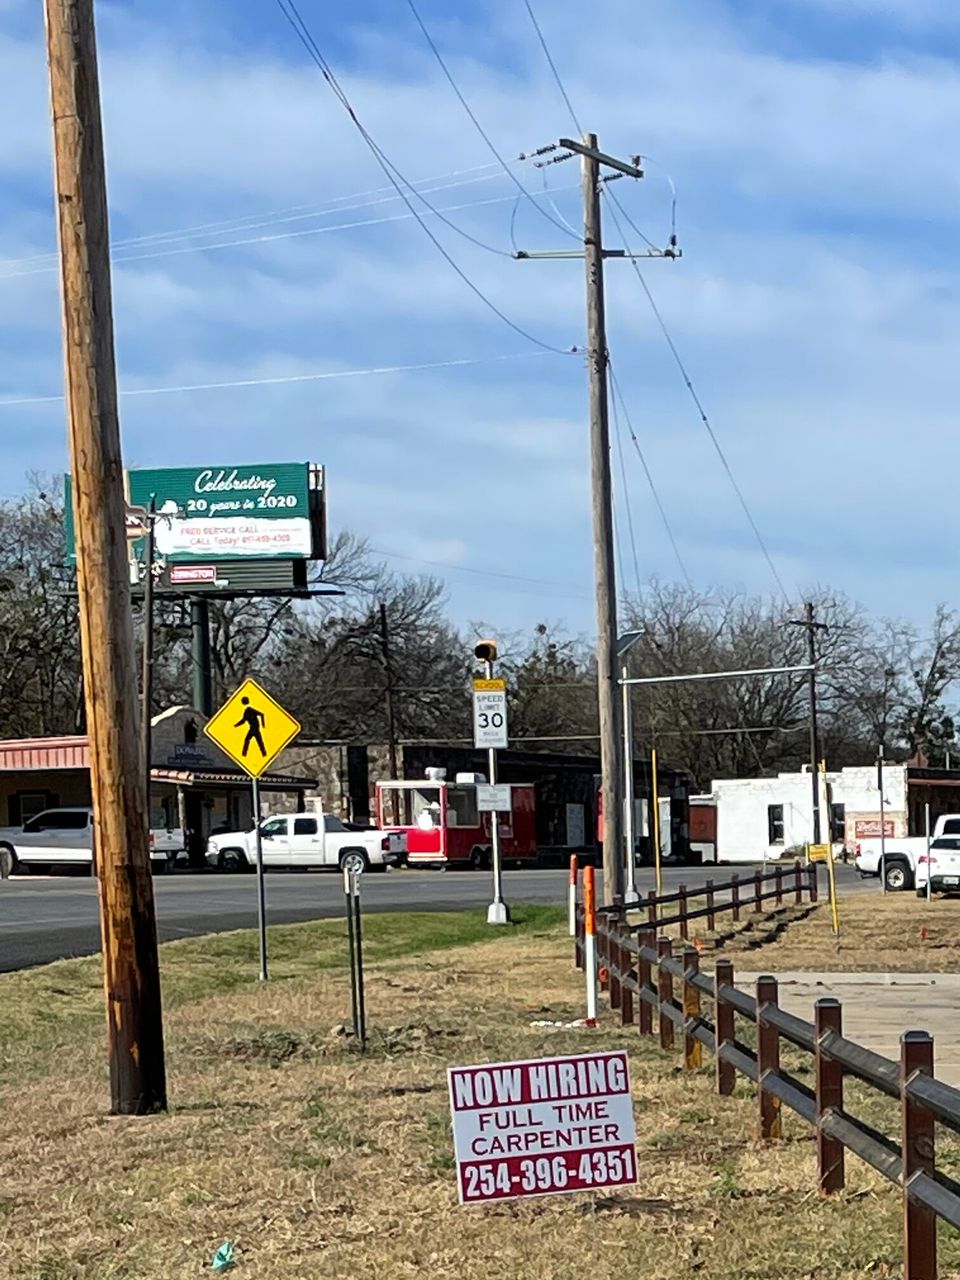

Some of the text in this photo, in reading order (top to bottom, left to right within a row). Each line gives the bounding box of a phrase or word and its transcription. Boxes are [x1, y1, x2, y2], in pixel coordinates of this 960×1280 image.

[194, 469, 277, 497] Celebrating
[187, 495, 298, 517] 20 years in 2020
[239, 525, 259, 533] CALL
[476, 694, 504, 703] SPEED
[478, 704, 501, 712] LIMIT
[478, 712, 504, 729] 30
[454, 1057, 626, 1108] NOW HIRING
[478, 1100, 610, 1132] FULL TIME
[471, 1123, 620, 1156] CARPENTER
[464, 1148, 634, 1197] 254-396-4351
